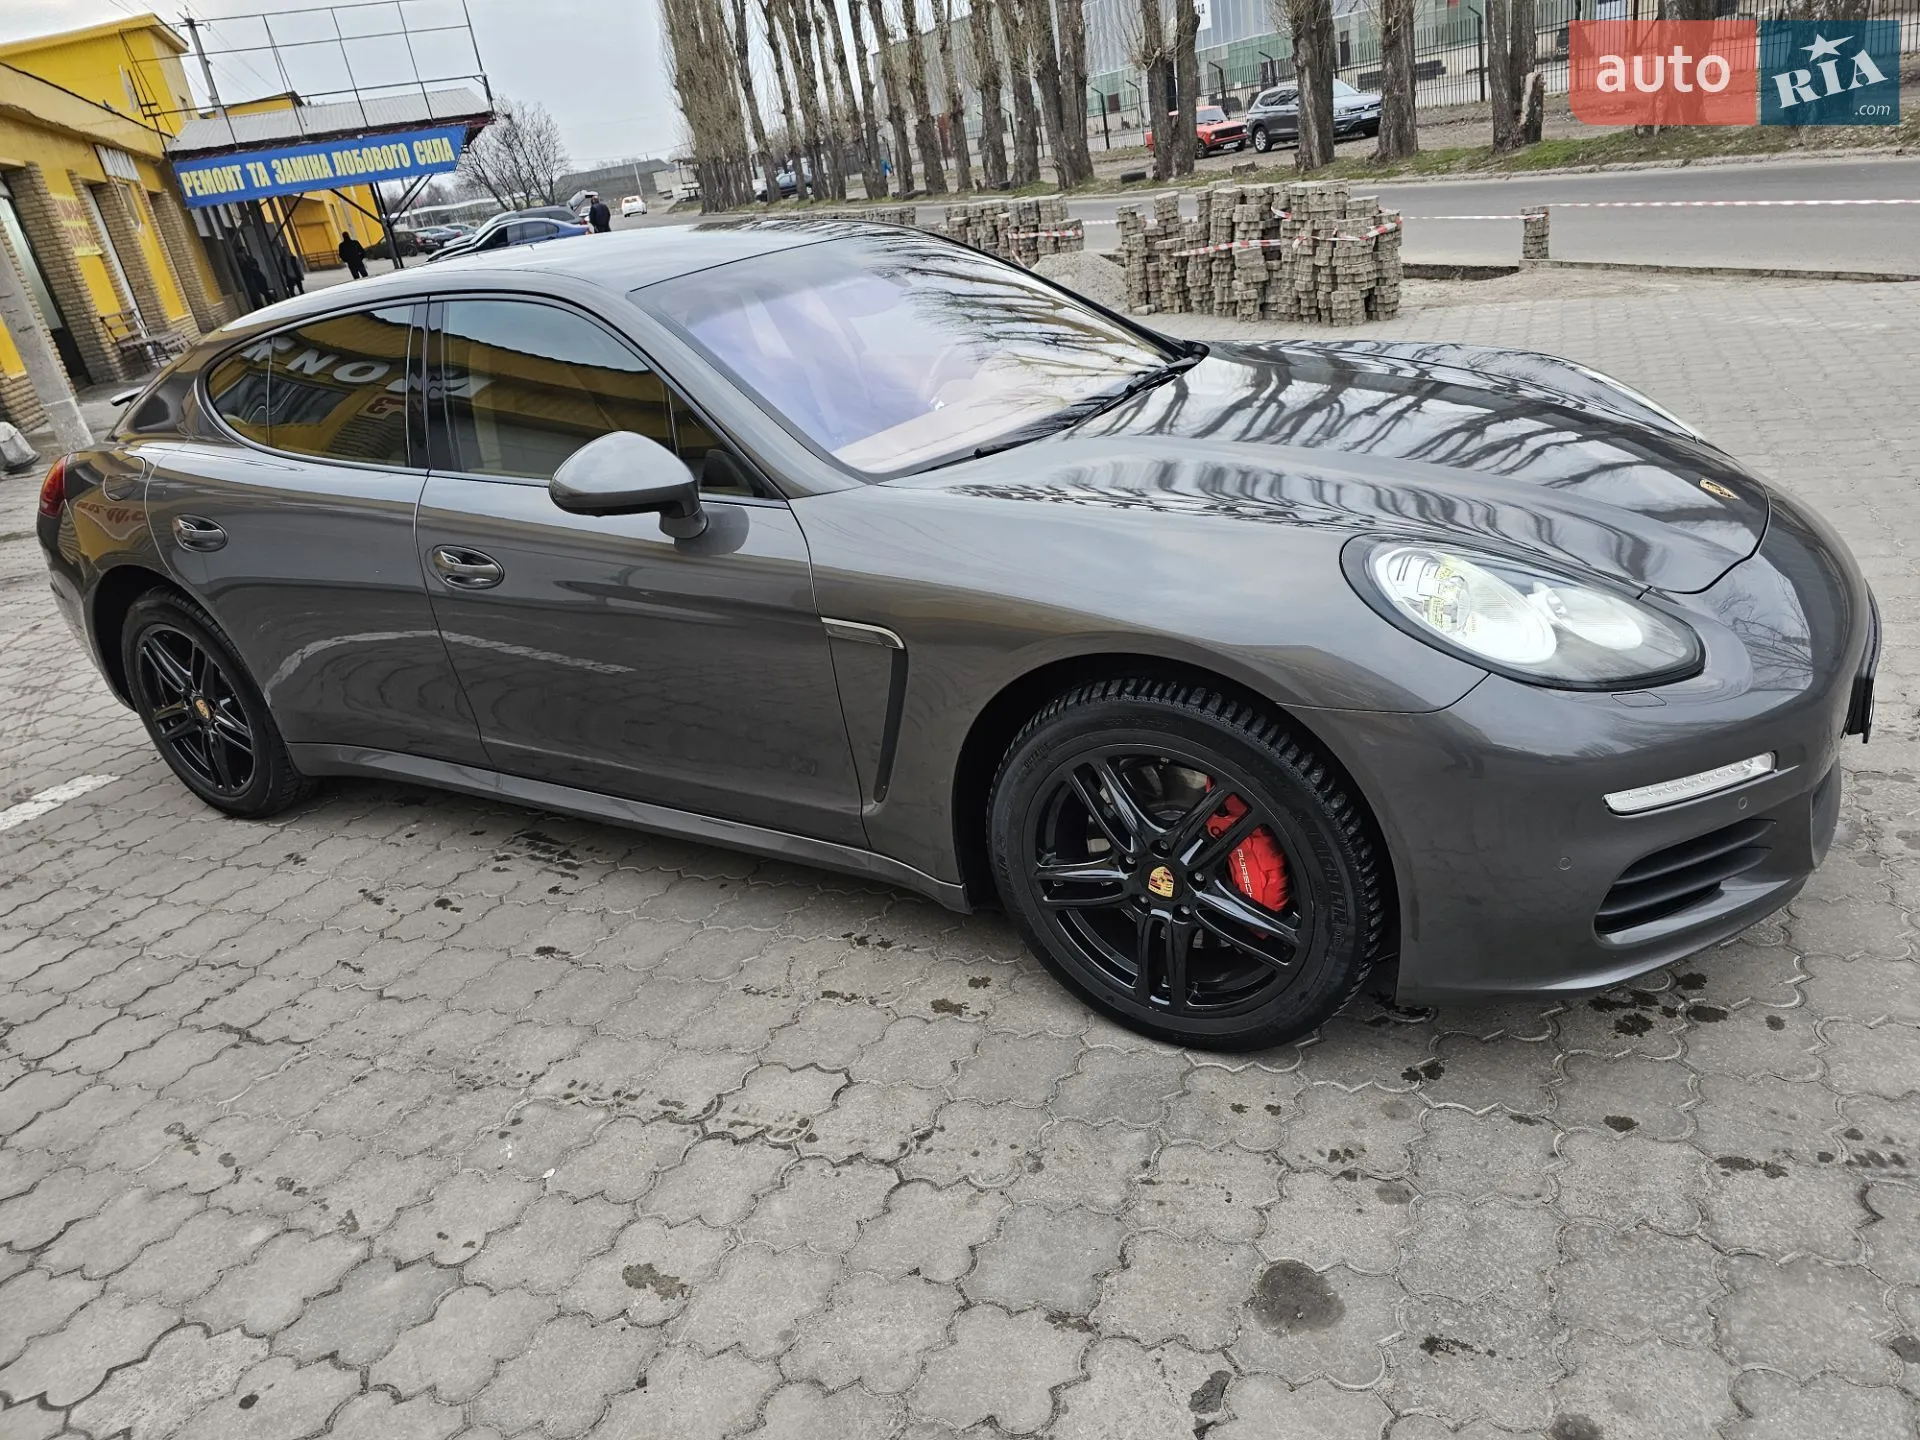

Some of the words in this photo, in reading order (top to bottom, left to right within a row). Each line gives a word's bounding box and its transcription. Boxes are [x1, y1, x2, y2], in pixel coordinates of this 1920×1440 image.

[179, 164, 246, 198] РЕМОНТ
[246, 161, 272, 188] ТА
[271, 153, 334, 184] ЗАМІНА
[331, 142, 411, 176] ЛОБОВОГО
[413, 137, 455, 166] СКЛА
